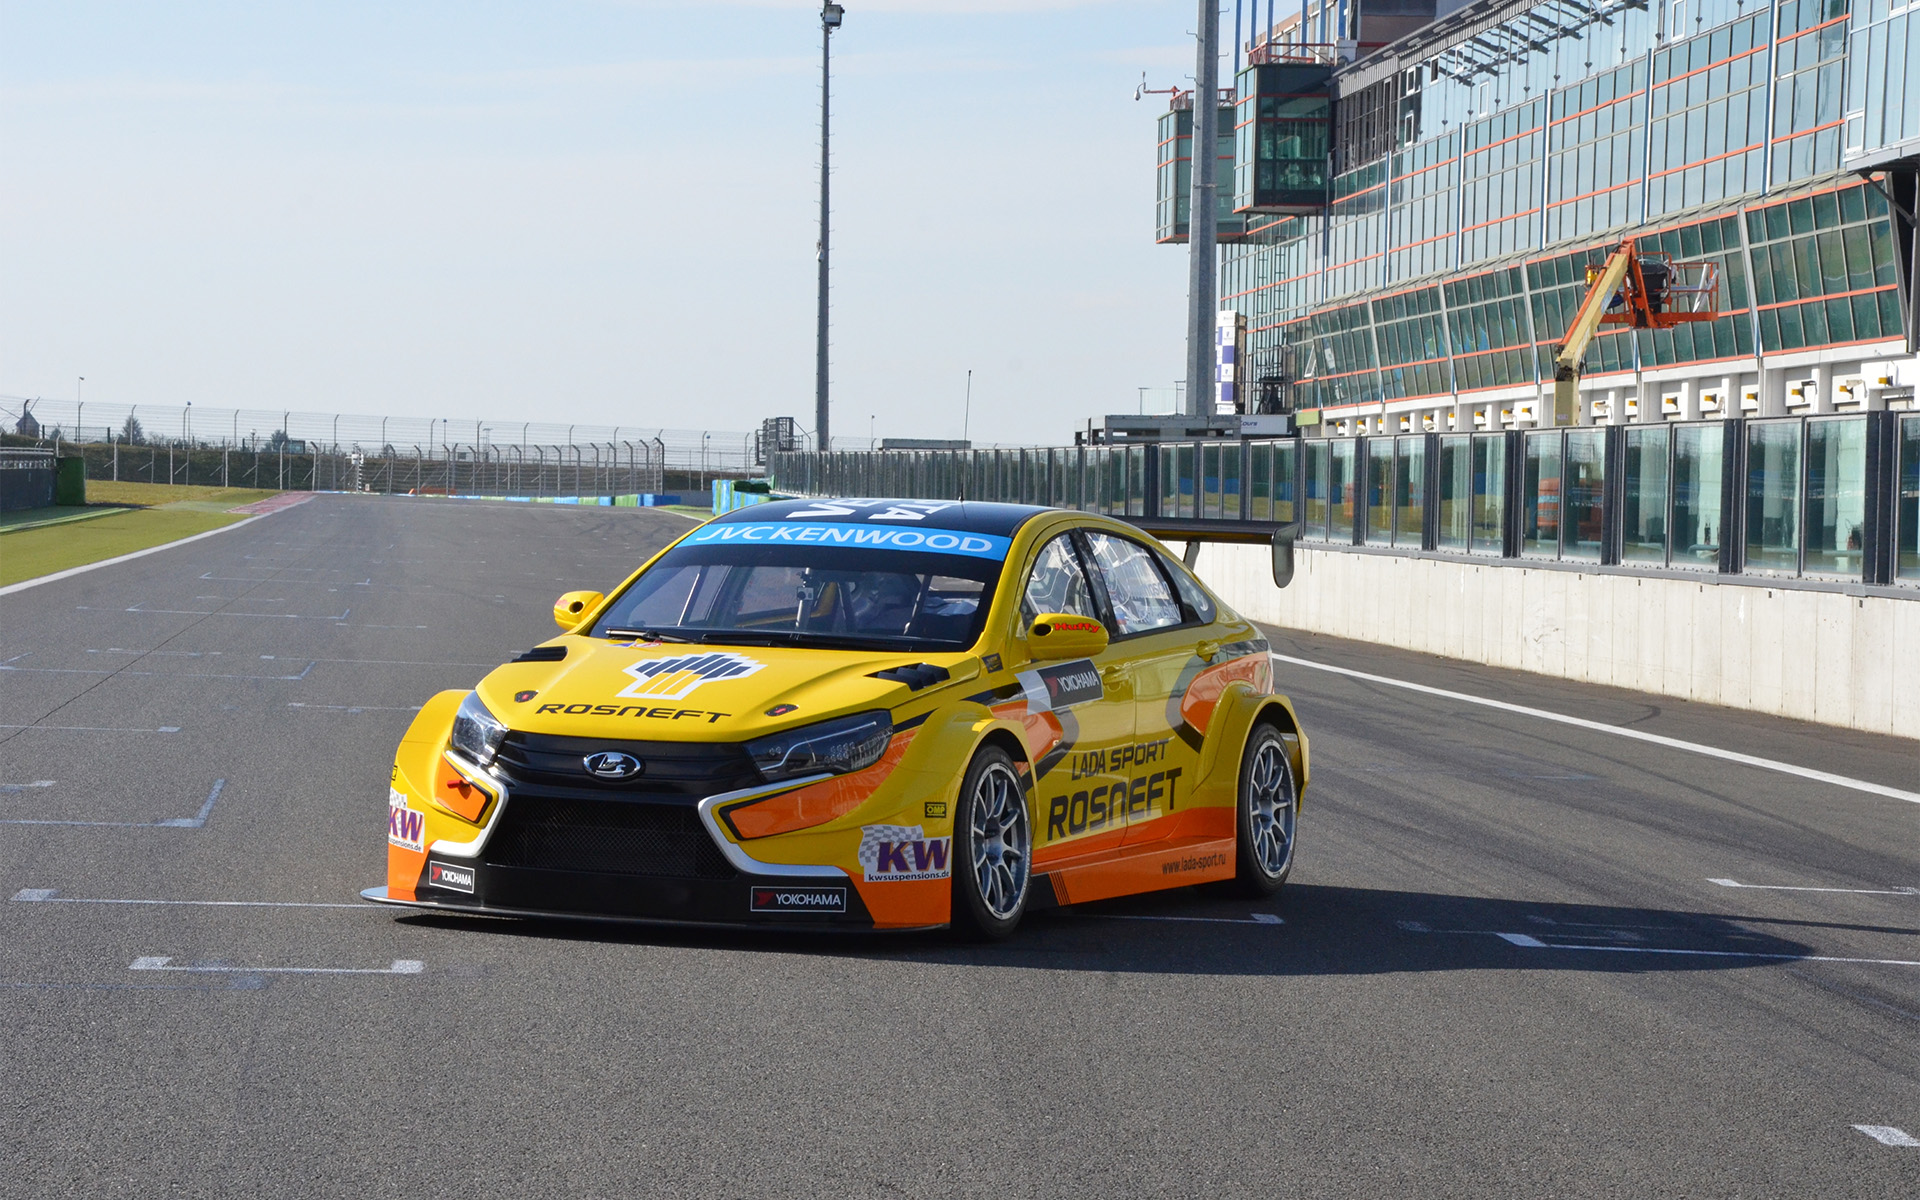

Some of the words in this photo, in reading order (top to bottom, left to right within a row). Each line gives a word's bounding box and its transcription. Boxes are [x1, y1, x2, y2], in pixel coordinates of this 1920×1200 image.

[696, 525, 993, 553] JVCKENWOOD
[1053, 622, 1100, 634] Huffy
[1057, 670, 1100, 693] YOKOHAMA
[535, 703, 732, 723] ROSNEFT
[1071, 749, 1106, 781] LADA
[1110, 740, 1168, 771] SPORT
[926, 805, 945, 814] OMP
[1047, 767, 1182, 841] ROSNEFT
[388, 806, 424, 843] KW
[876, 838, 951, 872] KW
[1162, 853, 1227, 875] www.lada-sport.ru
[441, 869, 472, 887] YOKOHAMA
[868, 870, 950, 881] kwsuspensions.de
[775, 893, 841, 905] YOKOHAMA
